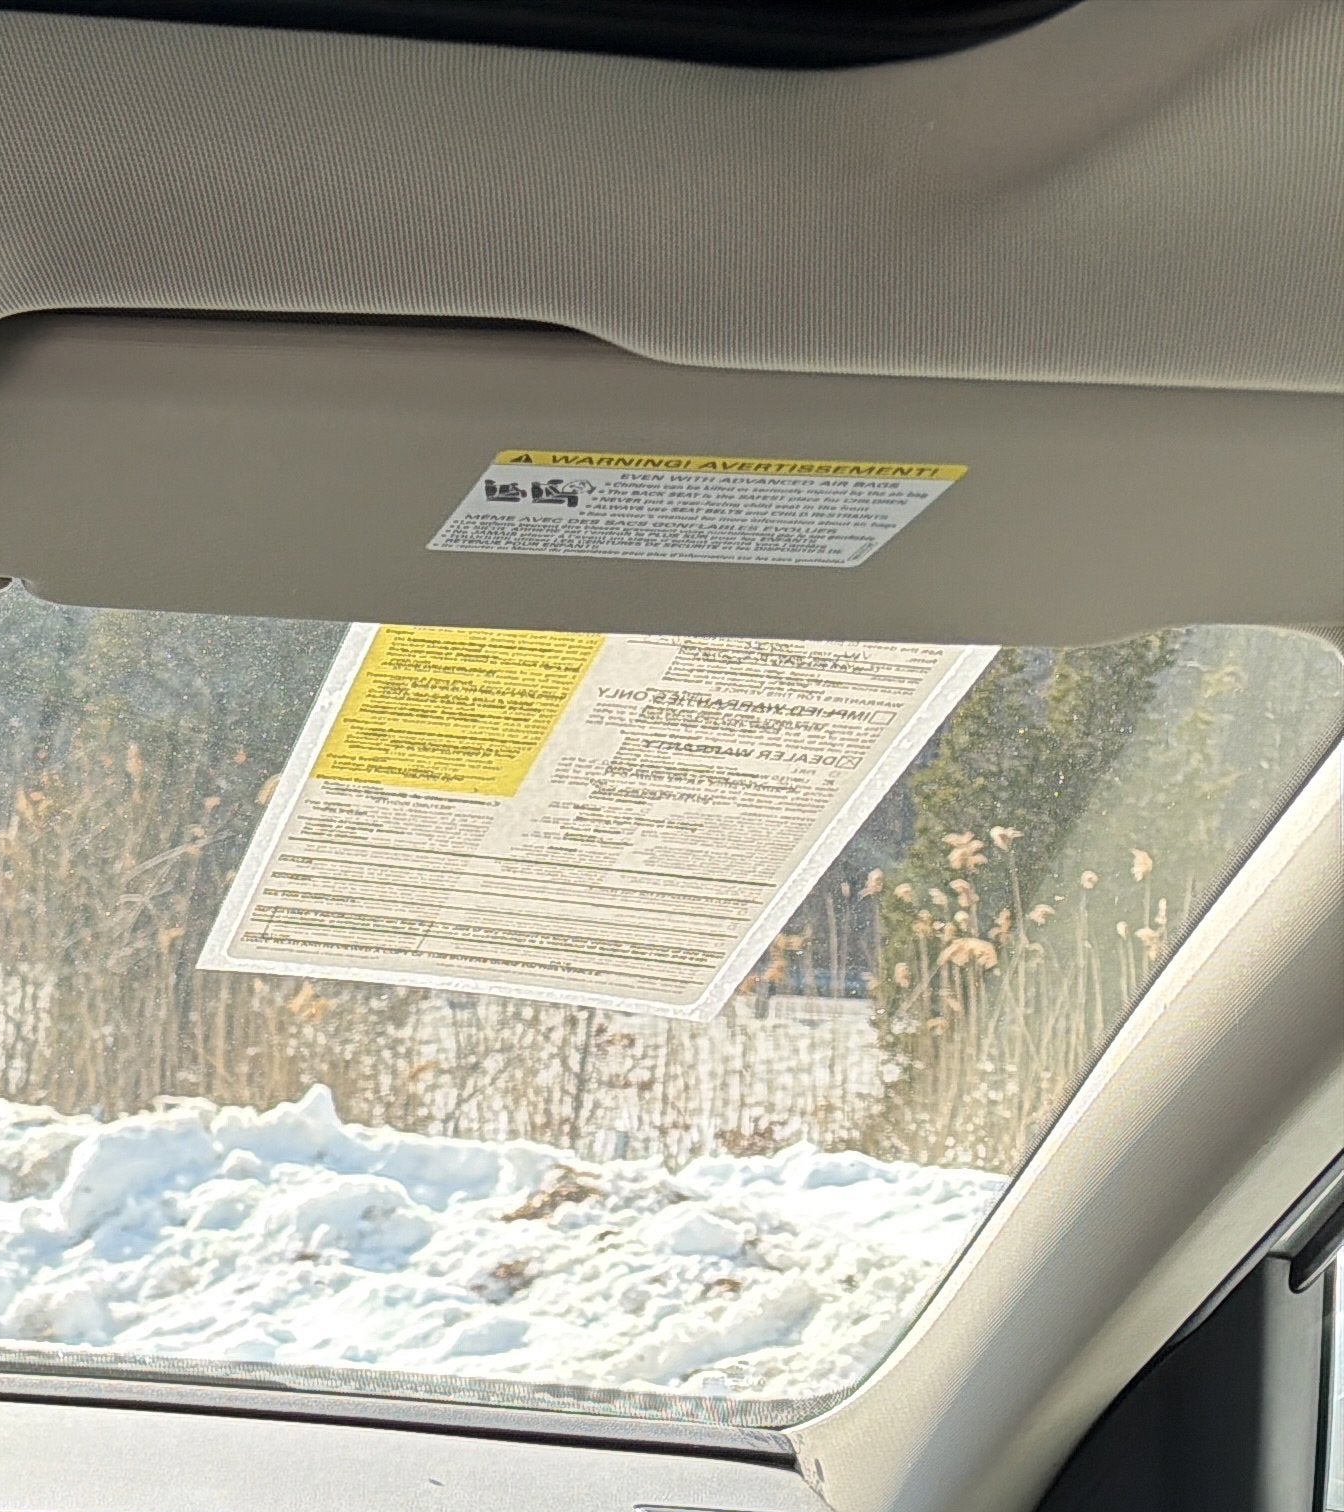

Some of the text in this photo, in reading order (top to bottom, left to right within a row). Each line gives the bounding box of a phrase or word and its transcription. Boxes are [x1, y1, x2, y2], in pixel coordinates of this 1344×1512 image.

[551, 455, 939, 477] WARNING! AVERTISSEMENT!
[671, 475, 715, 483] WITH
[719, 477, 815, 486] ADVANCED
